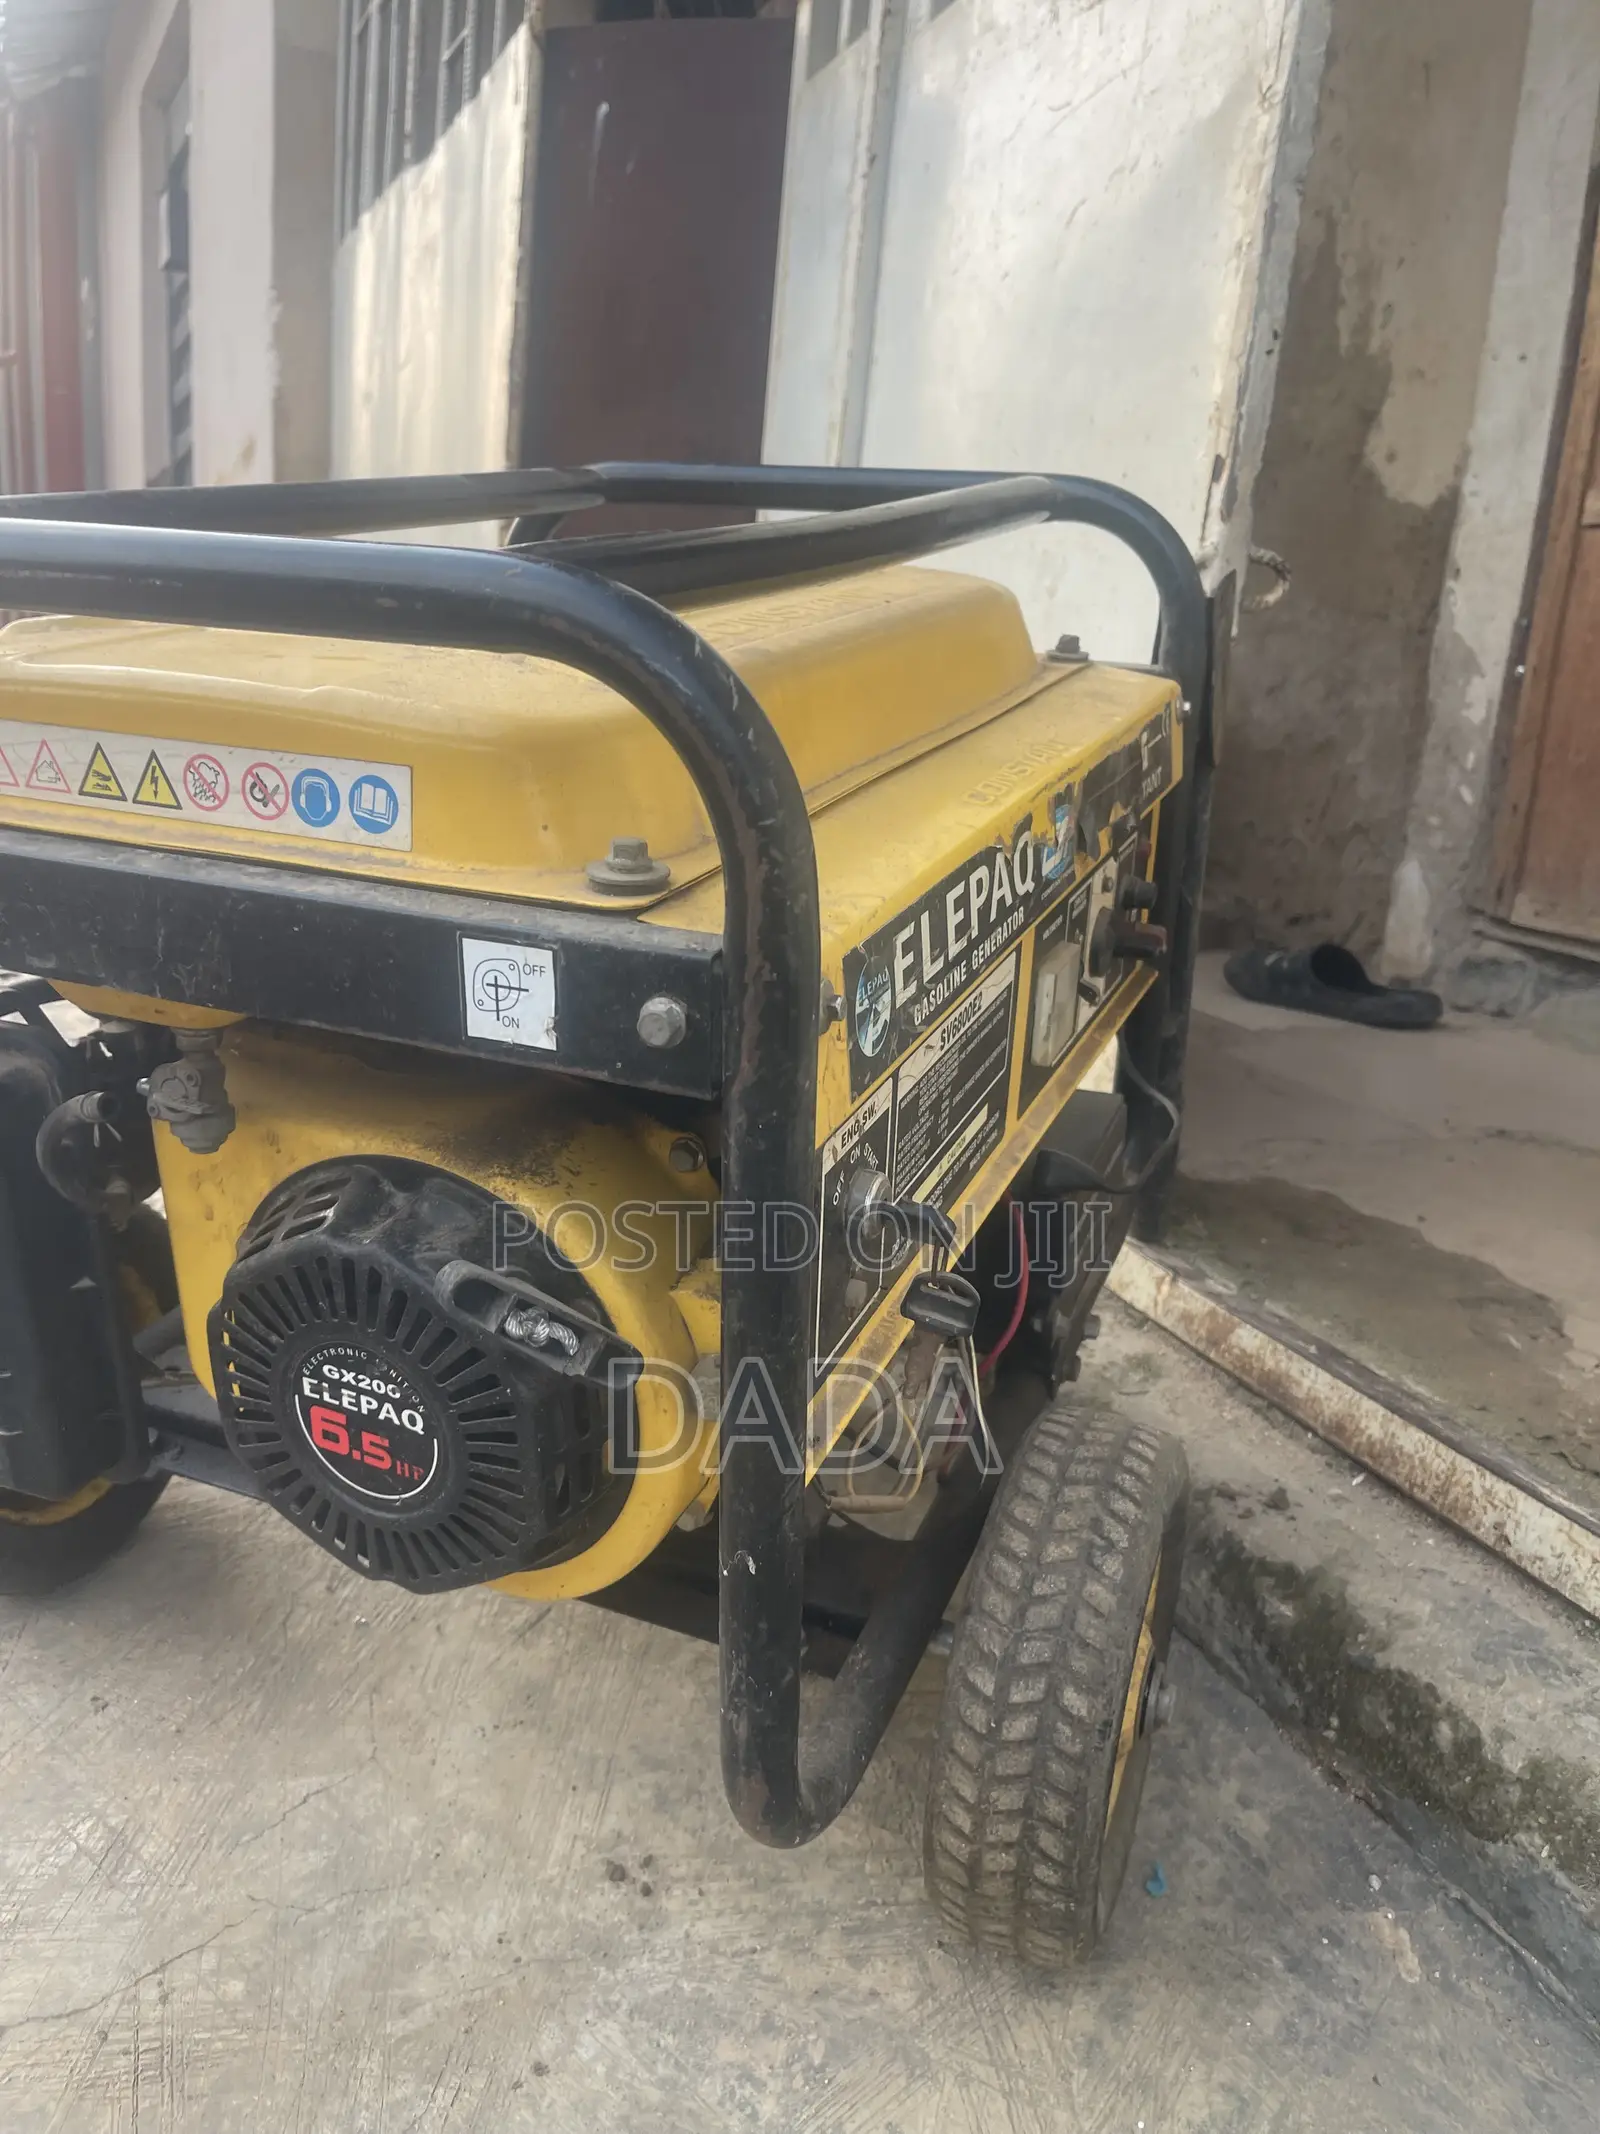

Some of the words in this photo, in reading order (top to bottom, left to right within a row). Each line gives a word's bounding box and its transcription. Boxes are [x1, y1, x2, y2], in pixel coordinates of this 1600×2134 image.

[894, 829, 1035, 1010] ELEPAQ
[522, 963, 547, 978] OFF
[914, 959, 967, 1026] GASOLINE
[971, 905, 1025, 969] GENERATOR
[502, 1015, 520, 1029] ON
[850, 1142, 861, 1164] ON
[863, 1142, 879, 1172] START
[832, 1170, 845, 1206] OFF
[302, 1347, 368, 1376] ELECTRONIC
[322, 1364, 401, 1399] GX200
[302, 1376, 425, 1436] ELEPAQ
[309, 1404, 392, 1471] 6.5
[396, 1458, 425, 1481] HP
